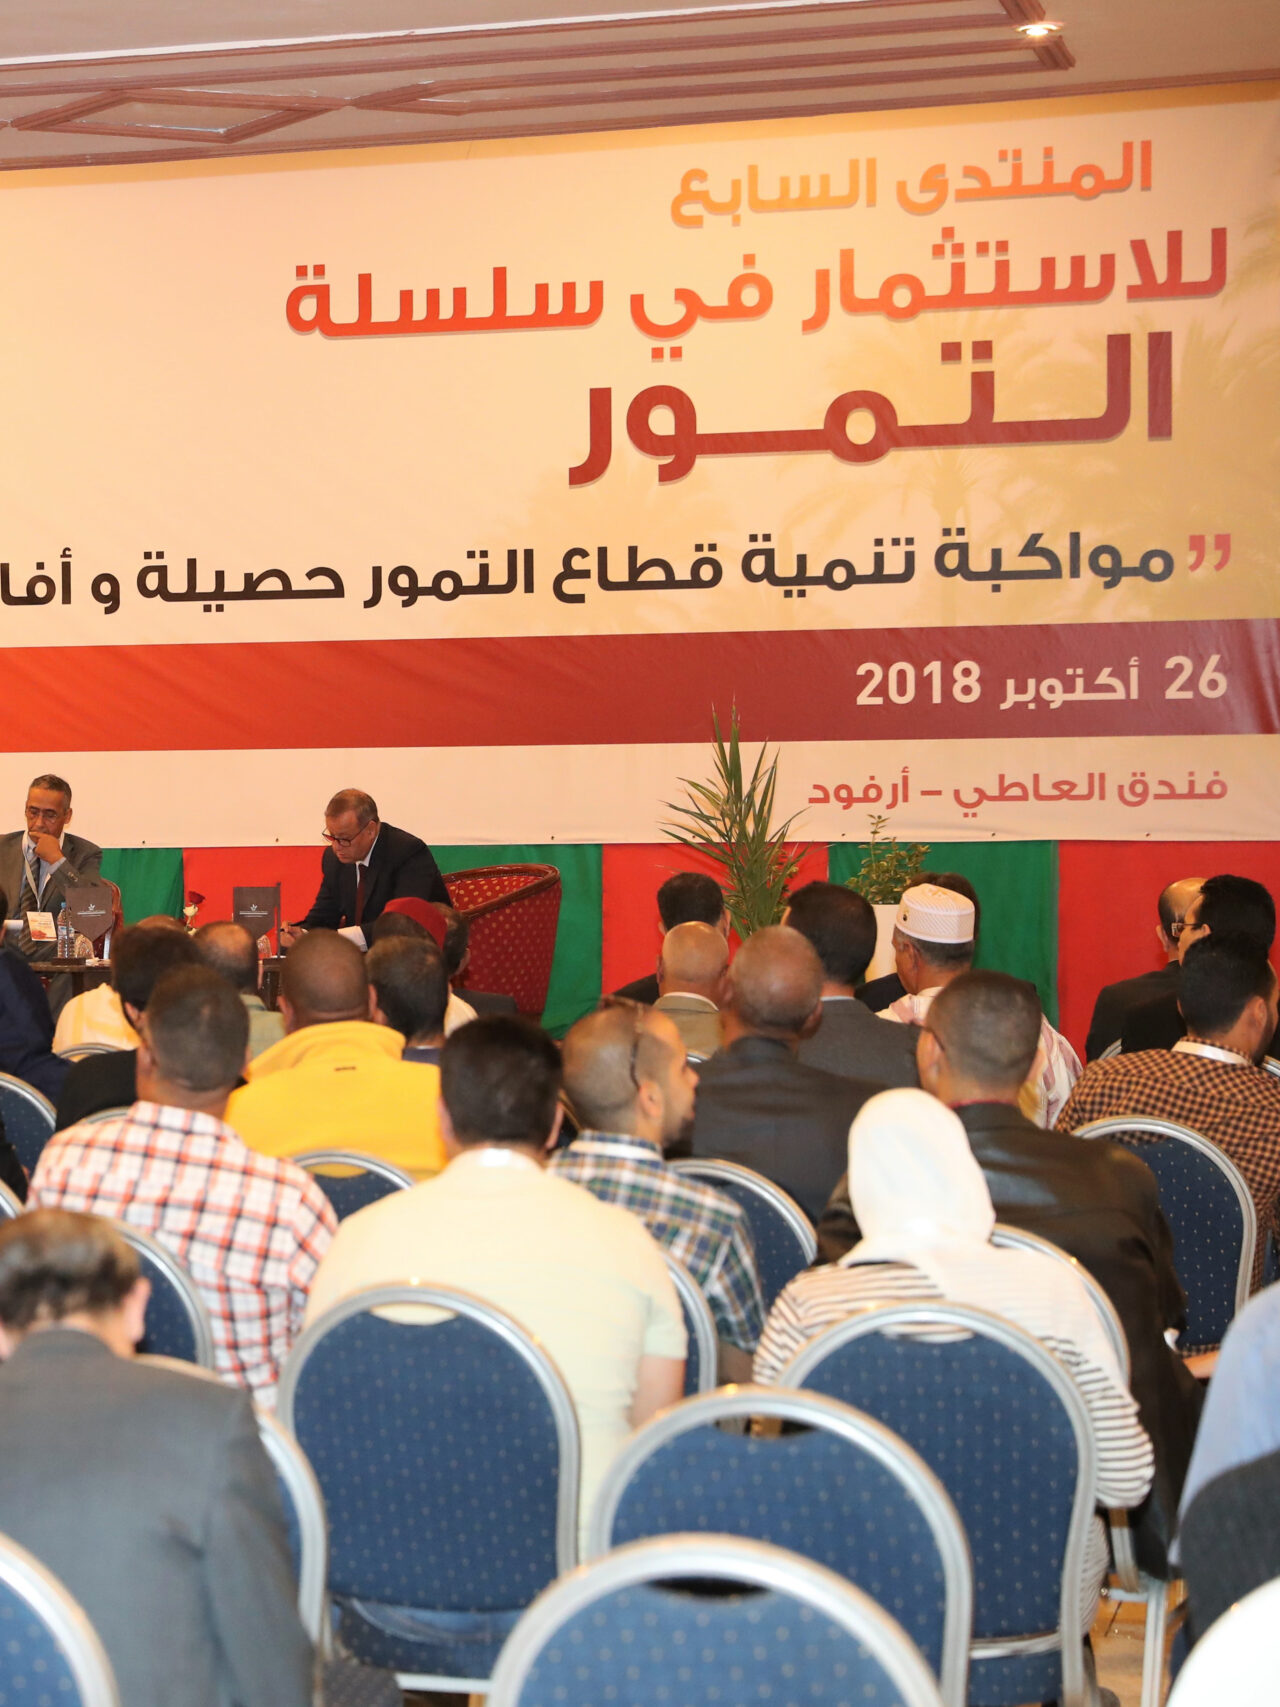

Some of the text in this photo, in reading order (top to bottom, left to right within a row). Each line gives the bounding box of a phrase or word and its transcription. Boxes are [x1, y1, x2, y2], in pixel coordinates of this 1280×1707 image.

[671, 140, 1153, 226] المنتدى السابع
[286, 226, 1228, 362] للاستثمار في سلسلة
[569, 331, 1174, 488] التمور
[137, 551, 345, 613] حصيلة
[363, 549, 534, 609] التمور
[552, 543, 723, 604] قطاع
[741, 533, 915, 598] تنمية
[934, 527, 1175, 594] مواكبة
[856, 654, 1228, 710] 26 أكتوبر 2018
[808, 767, 910, 810] أرفود
[953, 772, 1106, 818] العاطي
[1117, 771, 1229, 808] فندق
